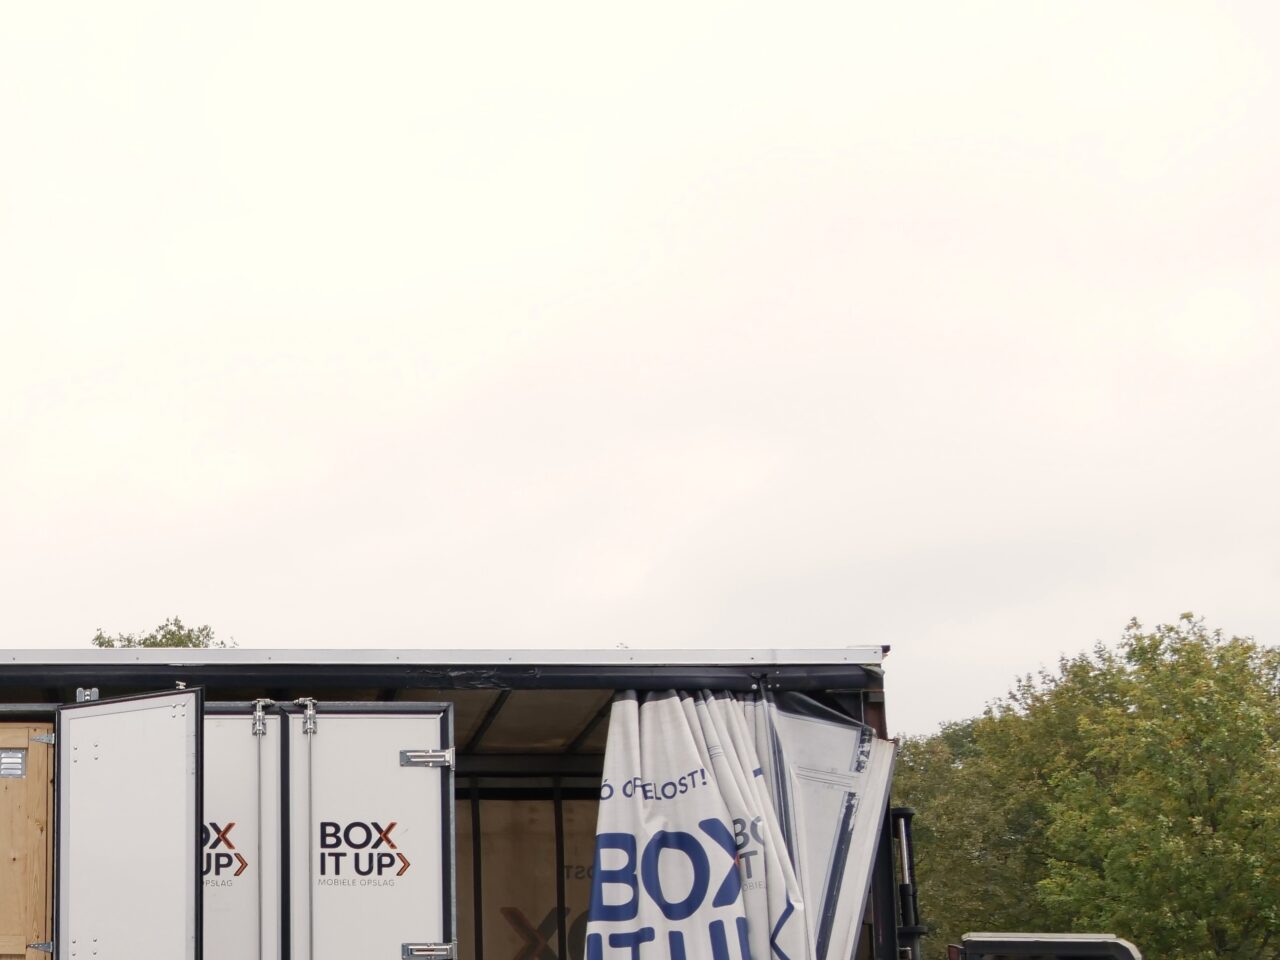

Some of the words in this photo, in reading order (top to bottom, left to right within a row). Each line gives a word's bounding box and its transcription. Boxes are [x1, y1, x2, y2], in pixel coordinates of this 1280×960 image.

[203, 822, 236, 849] X
[320, 821, 398, 849] BOX
[320, 852, 347, 877] IT
[354, 852, 396, 877] UP
[587, 818, 743, 922] BOX
[739, 850, 758, 879] T
[203, 879, 233, 887] PSLAG
[318, 878, 357, 887] MOBIELE
[359, 879, 395, 887] OPSLAG
